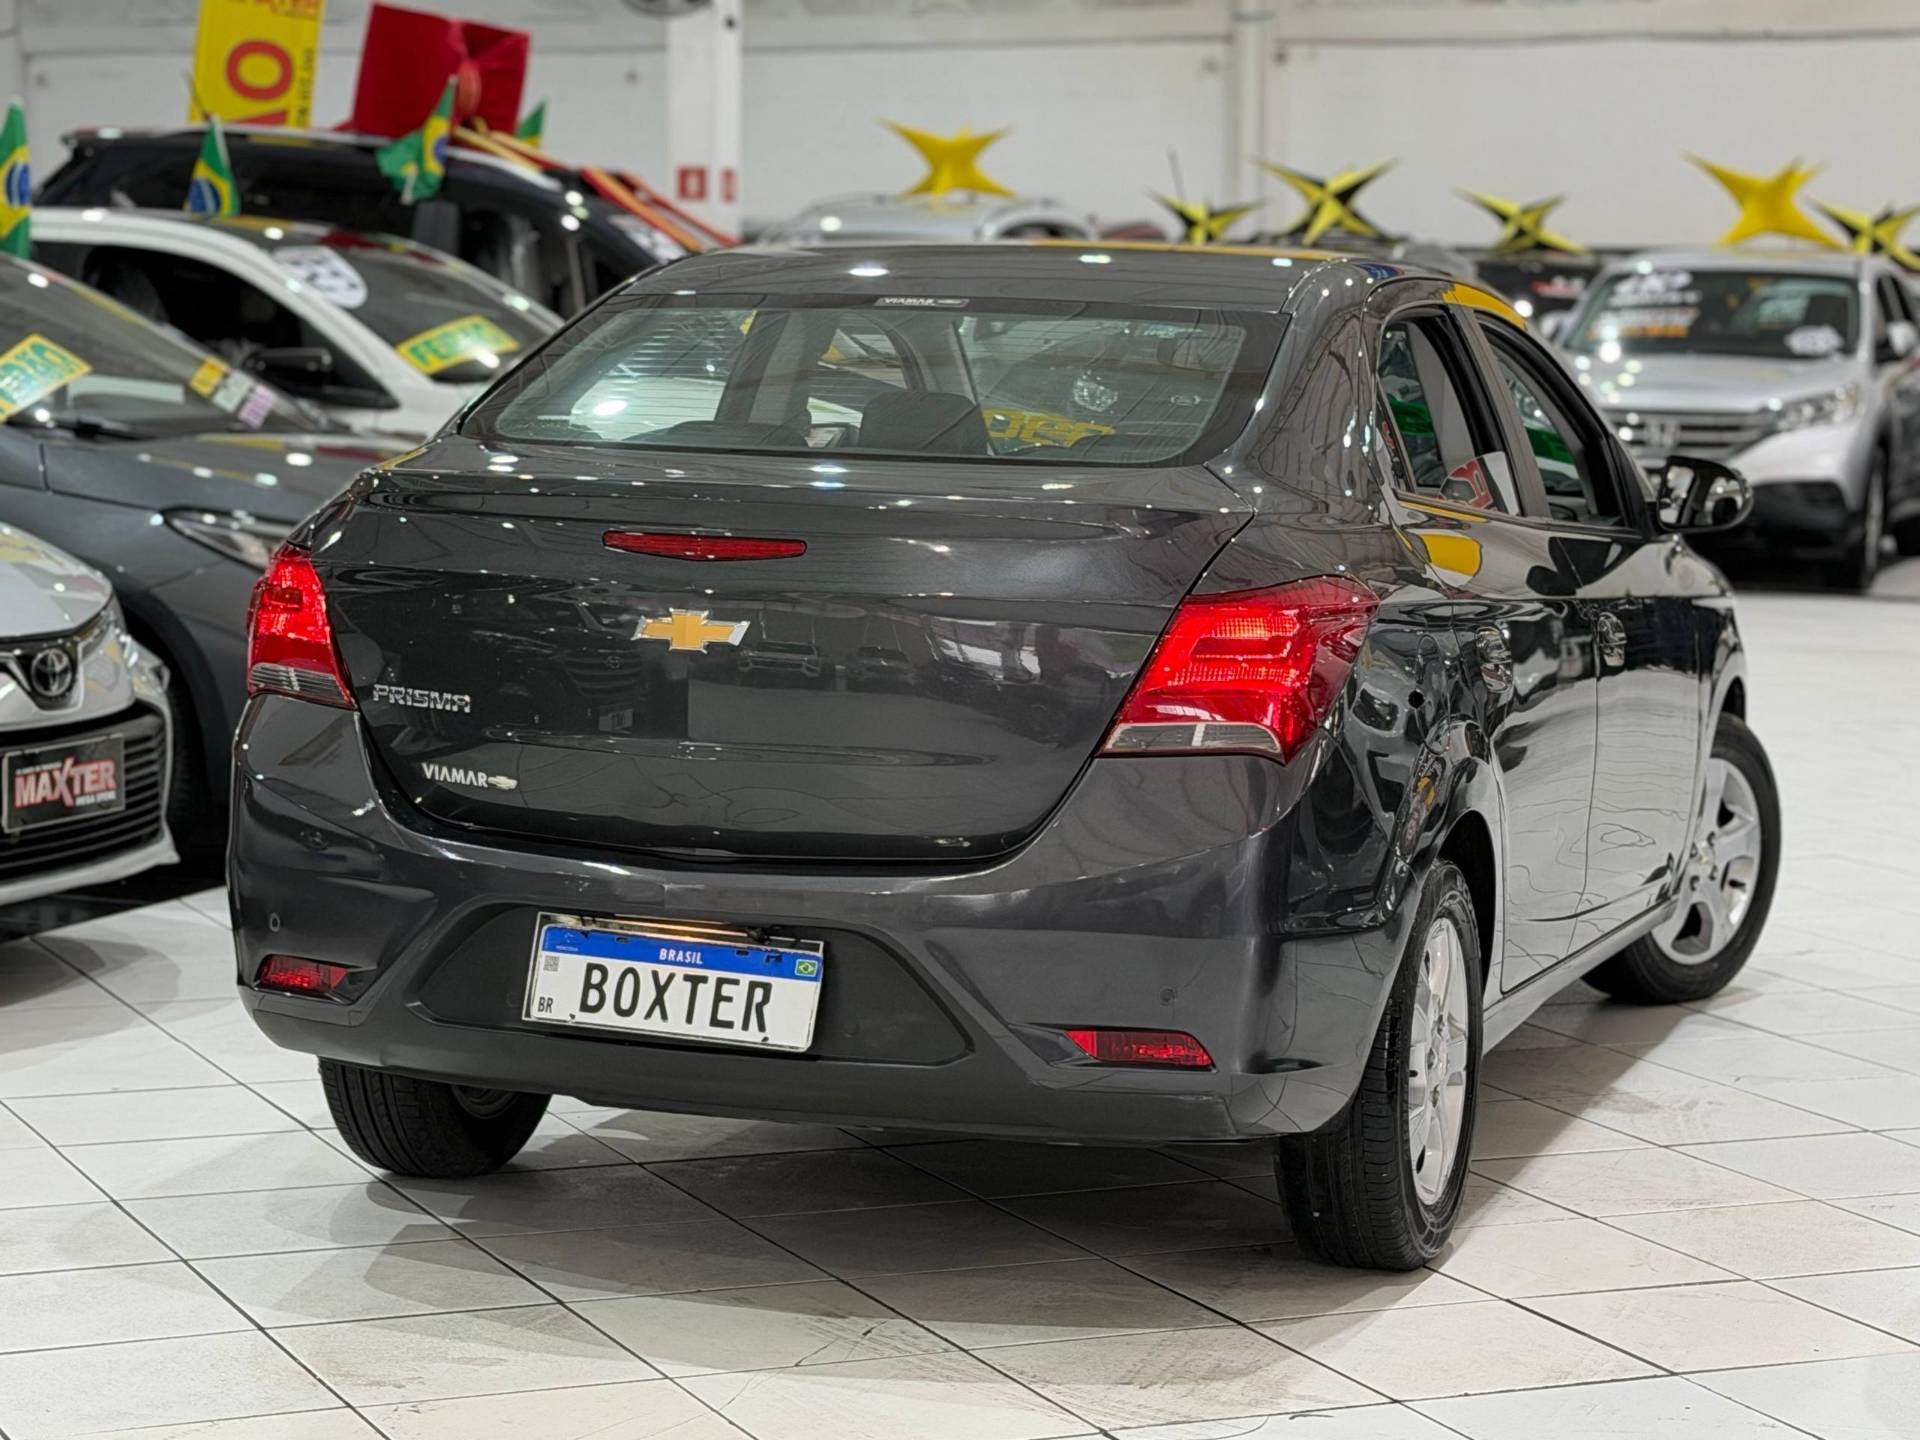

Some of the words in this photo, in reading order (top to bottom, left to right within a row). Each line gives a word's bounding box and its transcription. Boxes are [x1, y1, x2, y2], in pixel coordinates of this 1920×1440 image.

[373, 684, 471, 713] PRISMA
[15, 757, 117, 808] MAXTER
[422, 762, 488, 788] VIAMAR
[659, 948, 703, 965] BRASIL
[538, 996, 553, 1013] BR
[579, 962, 773, 1033] BOXTER
